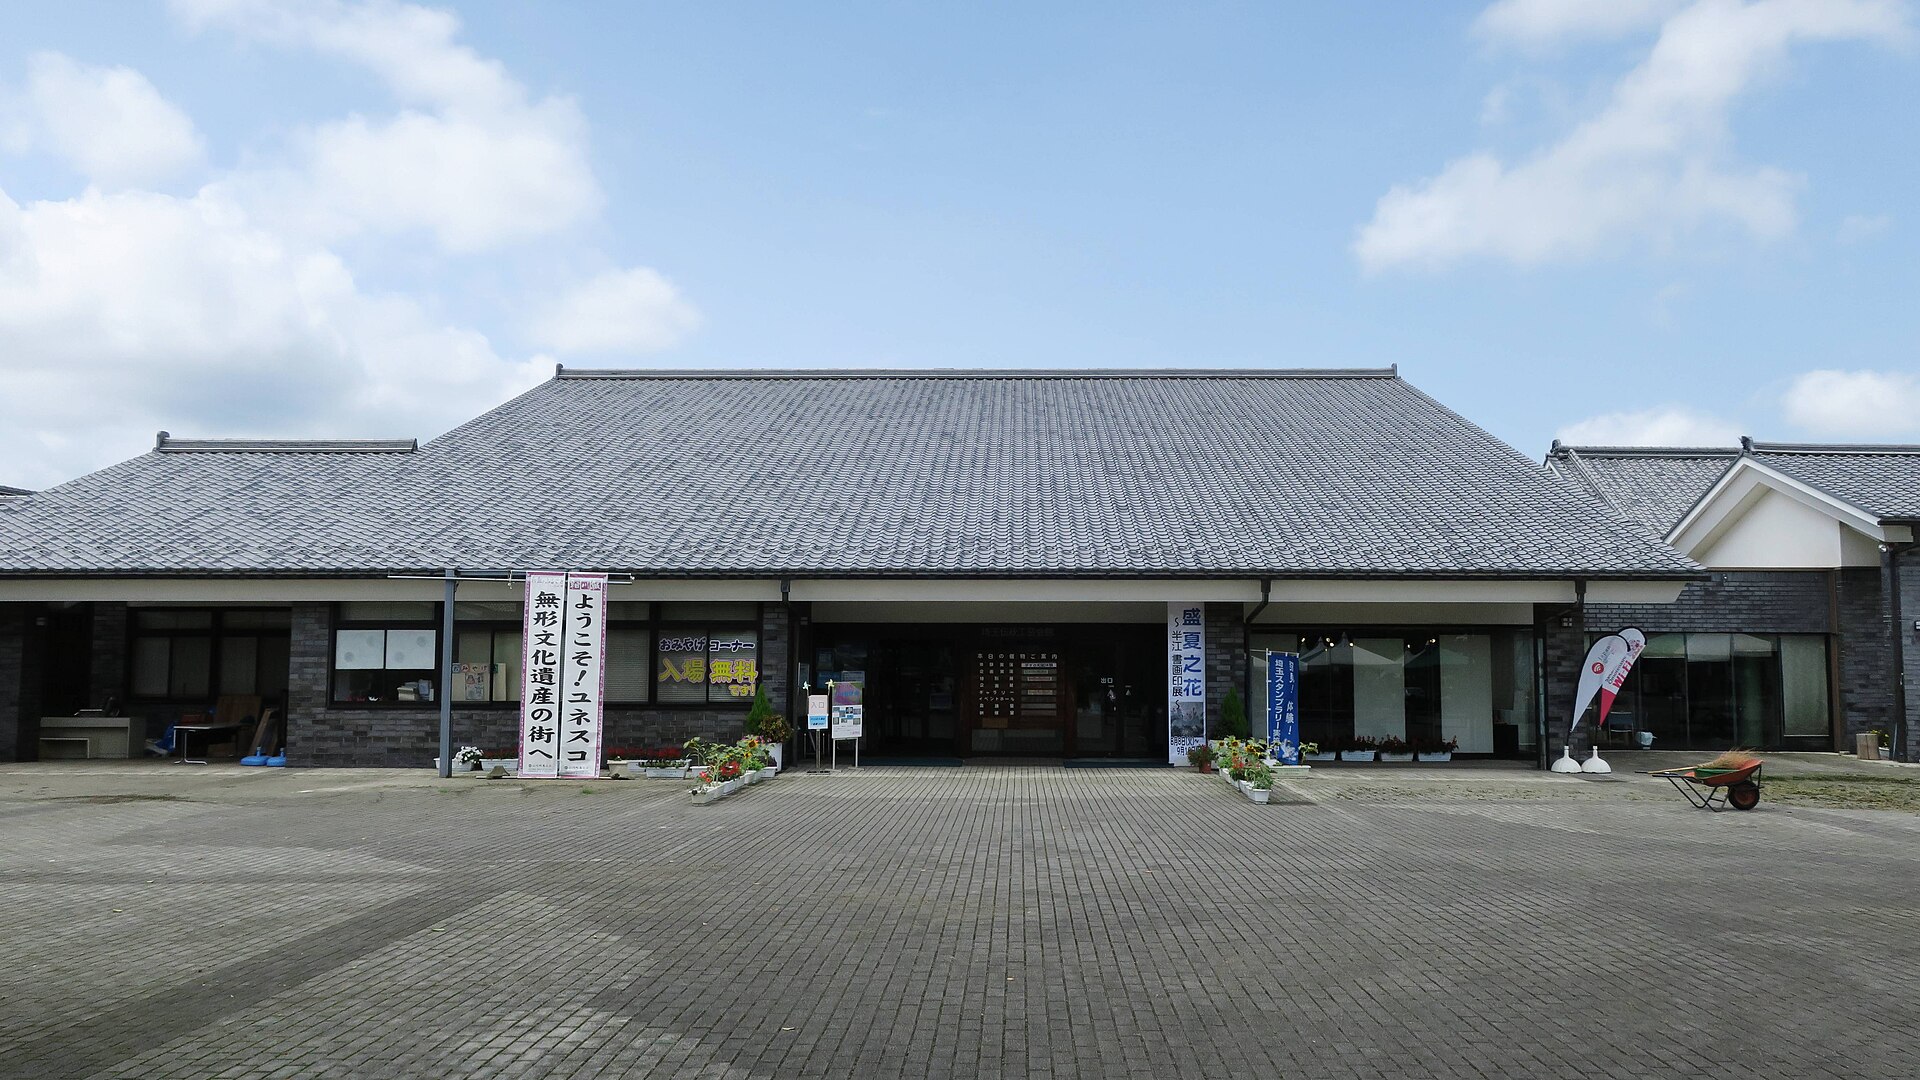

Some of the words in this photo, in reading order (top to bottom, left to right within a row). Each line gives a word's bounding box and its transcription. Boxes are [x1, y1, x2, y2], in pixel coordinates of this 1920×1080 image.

[528, 590, 561, 760] 無形文化遺産の街へ
[567, 593, 594, 761] ようこそ！ユネスコ
[1182, 608, 1202, 697] 盛夏之花
[1612, 660, 1633, 689] Wi-Fi
